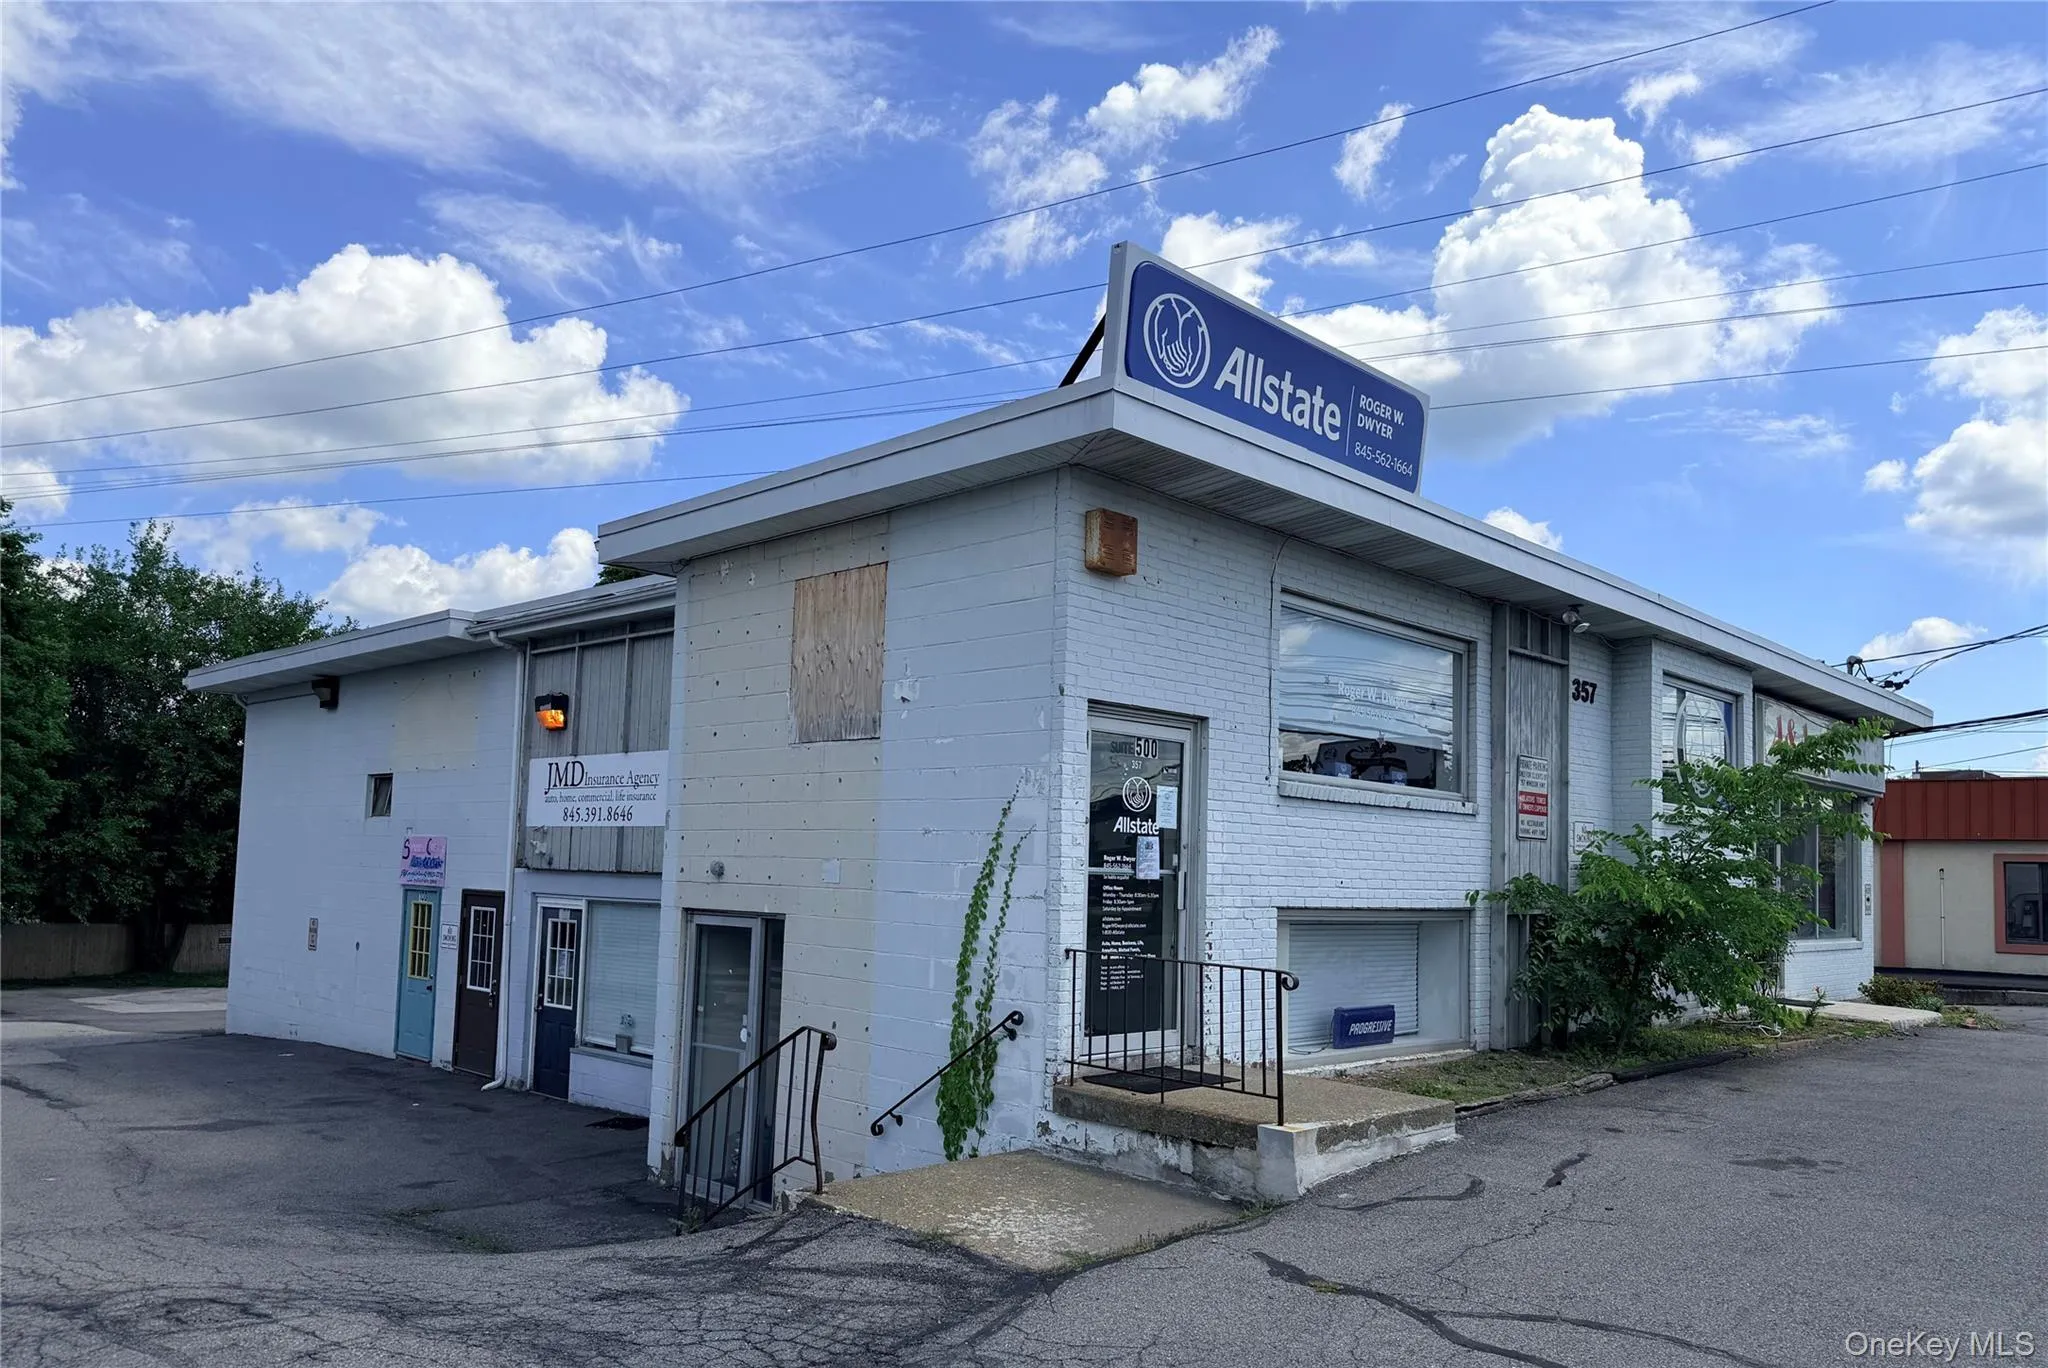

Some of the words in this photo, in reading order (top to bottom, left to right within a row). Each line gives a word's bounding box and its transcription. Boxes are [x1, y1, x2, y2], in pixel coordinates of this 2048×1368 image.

[1213, 347, 1342, 441] Allstate
[1358, 394, 1393, 423] ROGER
[1393, 409, 1405, 426] W.
[1356, 413, 1394, 440] DWYER
[1354, 442, 1413, 477] 845-562-1664
[1337, 680, 1365, 701] Roger
[1571, 678, 1598, 704] 357
[1135, 737, 1158, 758] 500
[1131, 760, 1142, 769] 357
[543, 760, 585, 796] JMD
[584, 771, 625, 786] Insurance
[626, 770, 660, 790] Agency
[615, 789, 626, 801] life
[626, 792, 657, 801] insurance
[562, 805, 634, 823] 845.391.8646
[1113, 816, 1160, 835] Allstate
[1348, 1020, 1393, 1036] PROGRESSIVE
